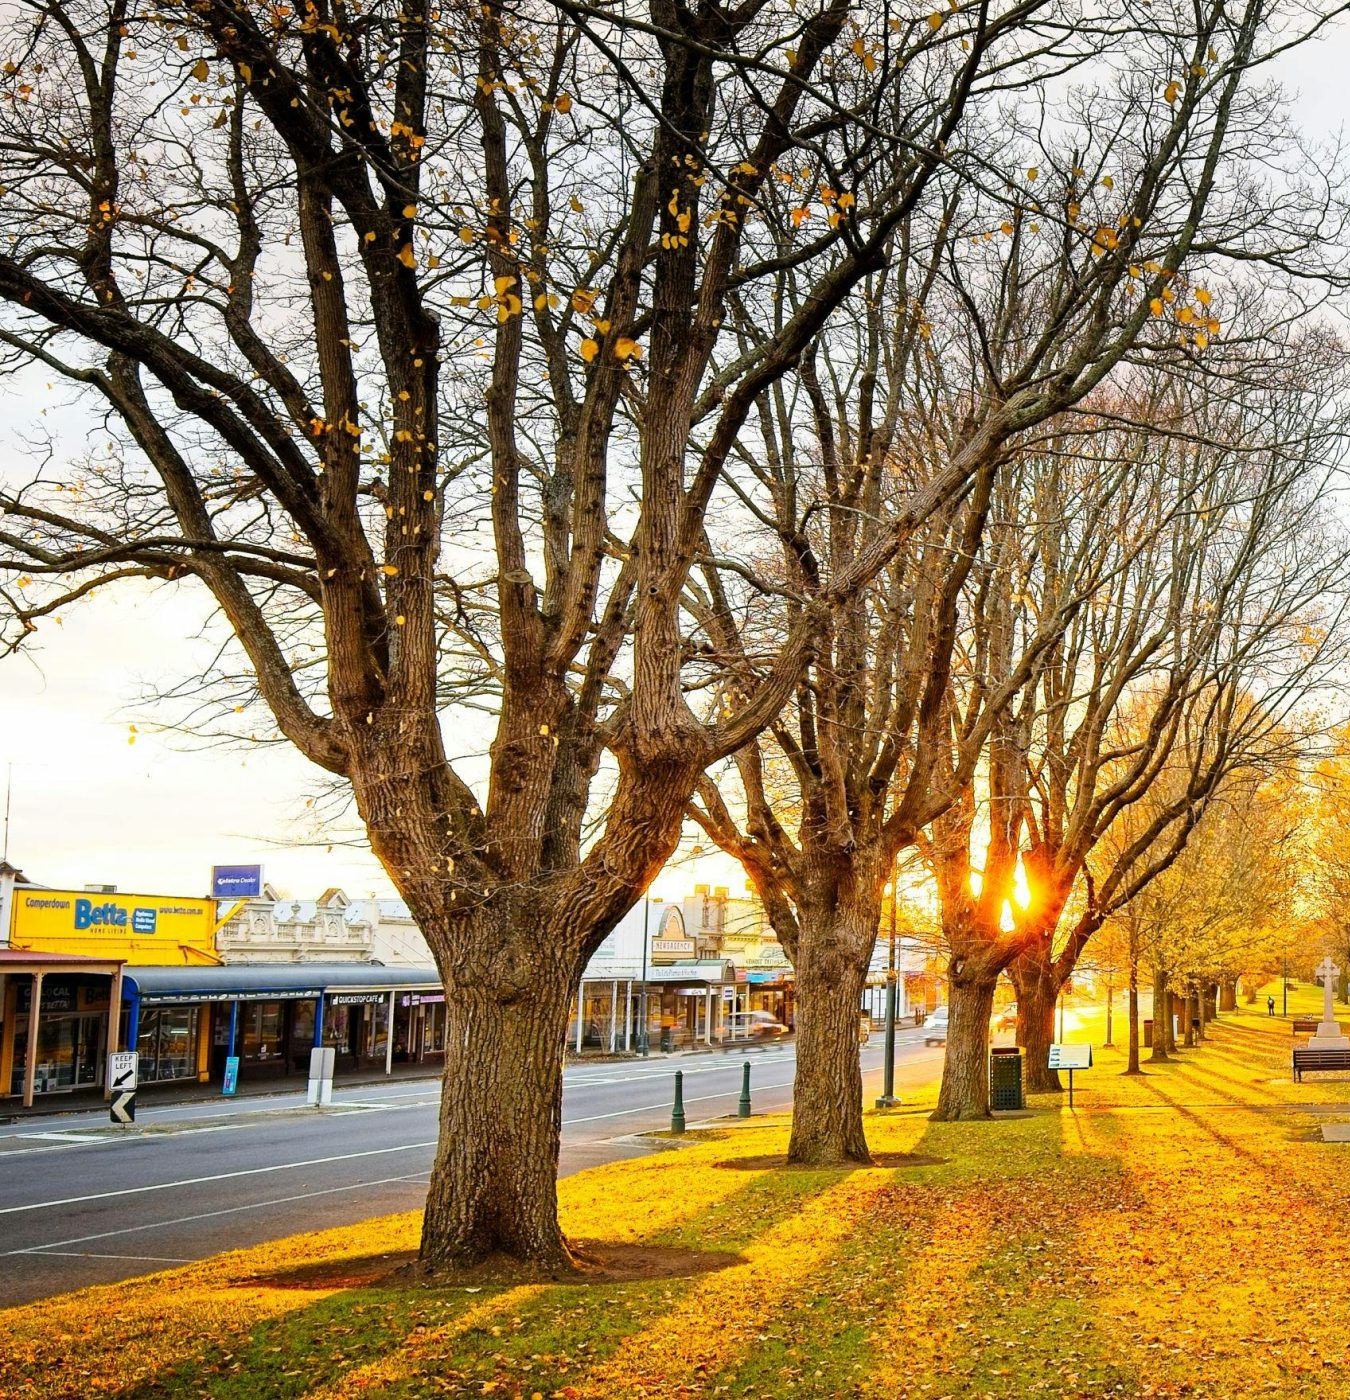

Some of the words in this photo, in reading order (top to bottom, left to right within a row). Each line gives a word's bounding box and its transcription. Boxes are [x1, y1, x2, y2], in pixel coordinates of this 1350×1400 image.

[26, 897, 70, 909] Camperdown
[74, 899, 128, 929] Betta
[655, 942, 690, 950] NEWSAGENCY
[339, 995, 366, 1004] QUICKSTOP
